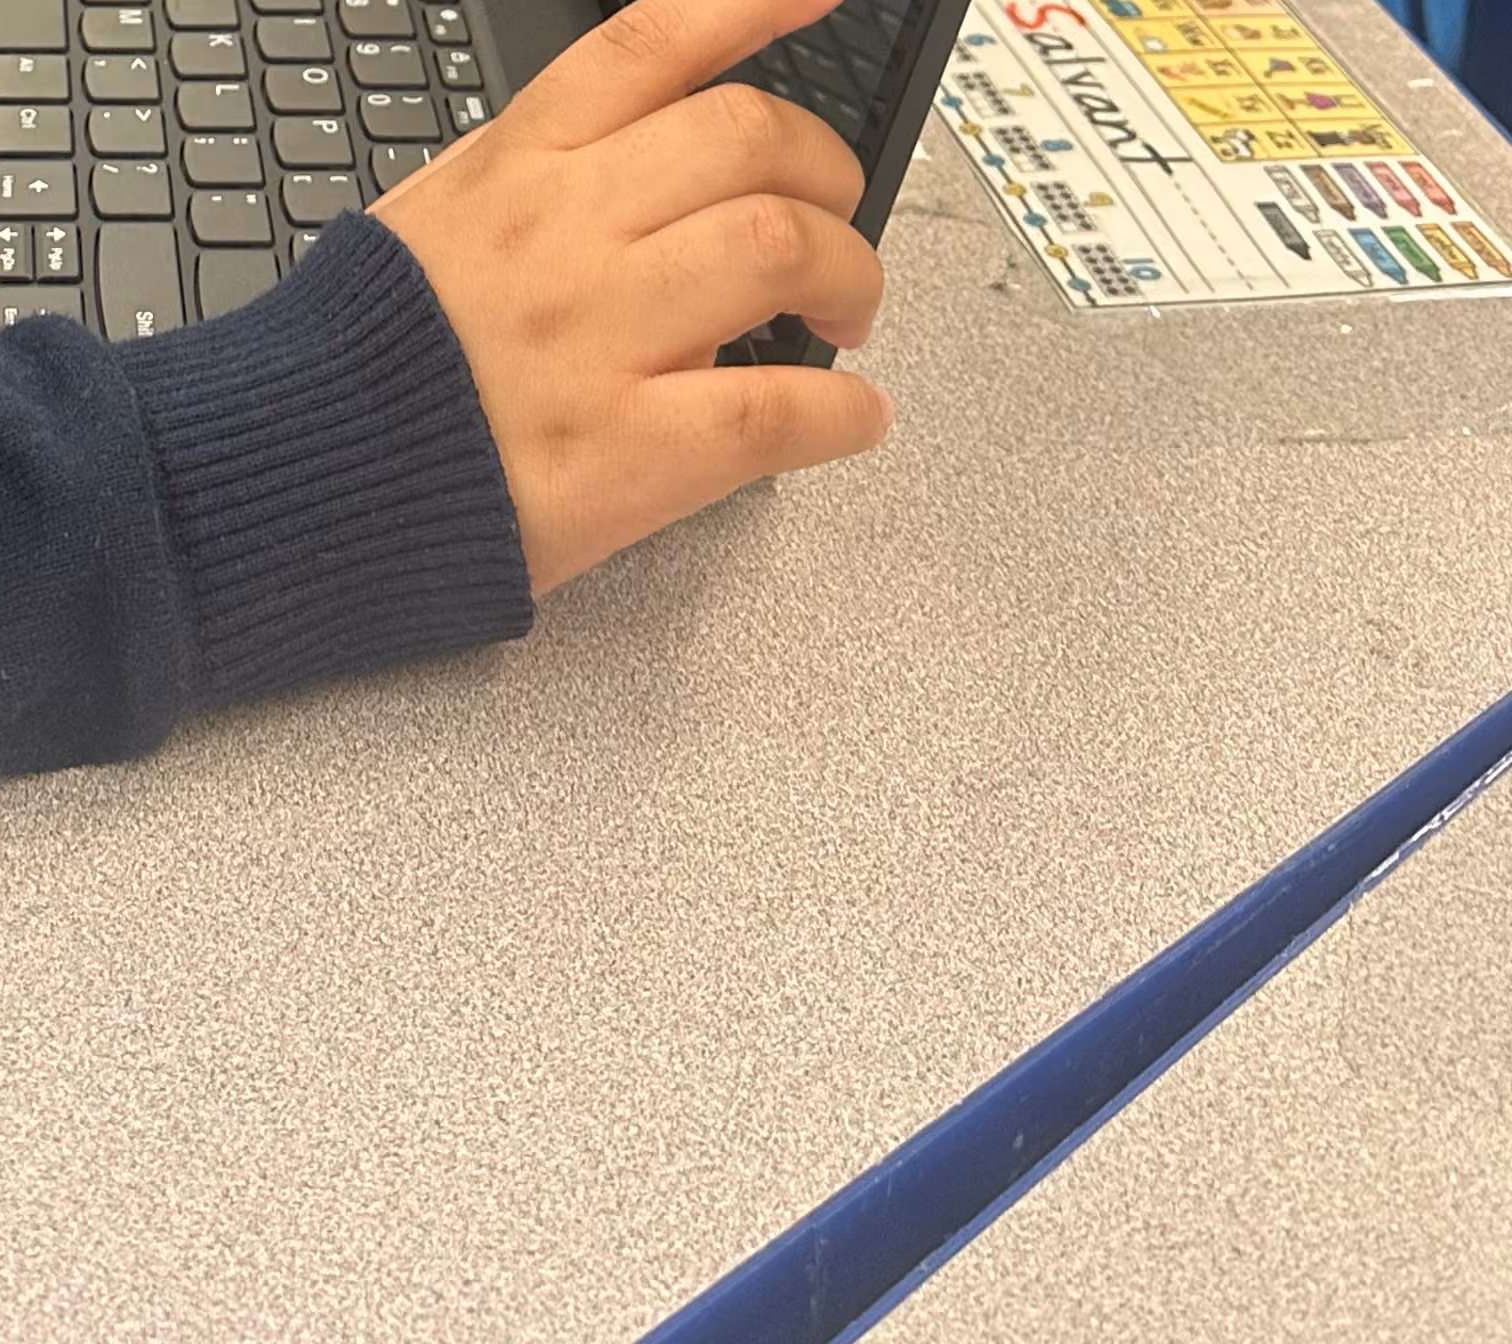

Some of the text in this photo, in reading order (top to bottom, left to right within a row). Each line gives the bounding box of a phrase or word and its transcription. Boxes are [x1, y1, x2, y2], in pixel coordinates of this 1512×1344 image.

[120, 10, 142, 24] M
[209, 34, 232, 46] K
[357, 44, 379, 54] 9
[303, 68, 328, 83] O
[216, 84, 239, 96] L
[1004, 1, 1195, 178] Salvant
[368, 94, 391, 105] 0
[313, 120, 338, 133] P
[1122, 257, 1162, 281] 10
